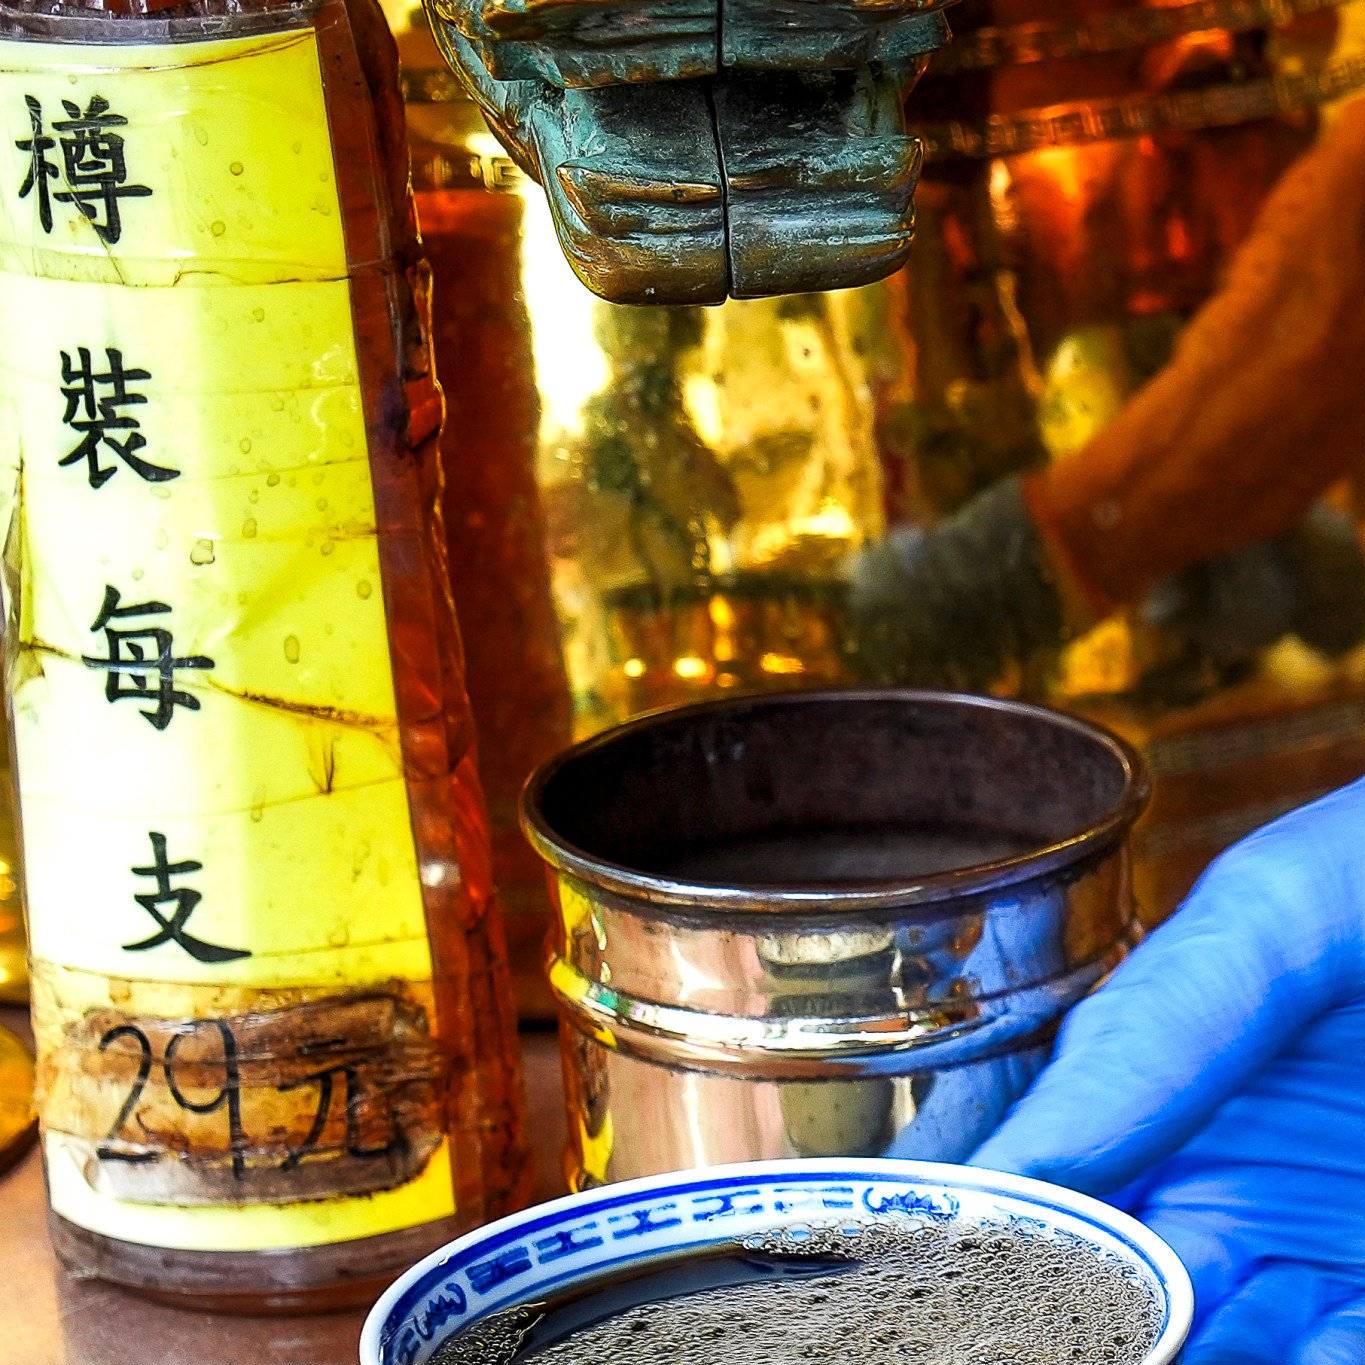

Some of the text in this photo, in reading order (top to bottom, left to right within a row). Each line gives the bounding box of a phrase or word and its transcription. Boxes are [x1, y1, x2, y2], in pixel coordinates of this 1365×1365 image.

[16, 94, 253, 963] 樽裝每支
[96, 1016, 415, 1182] 29元
